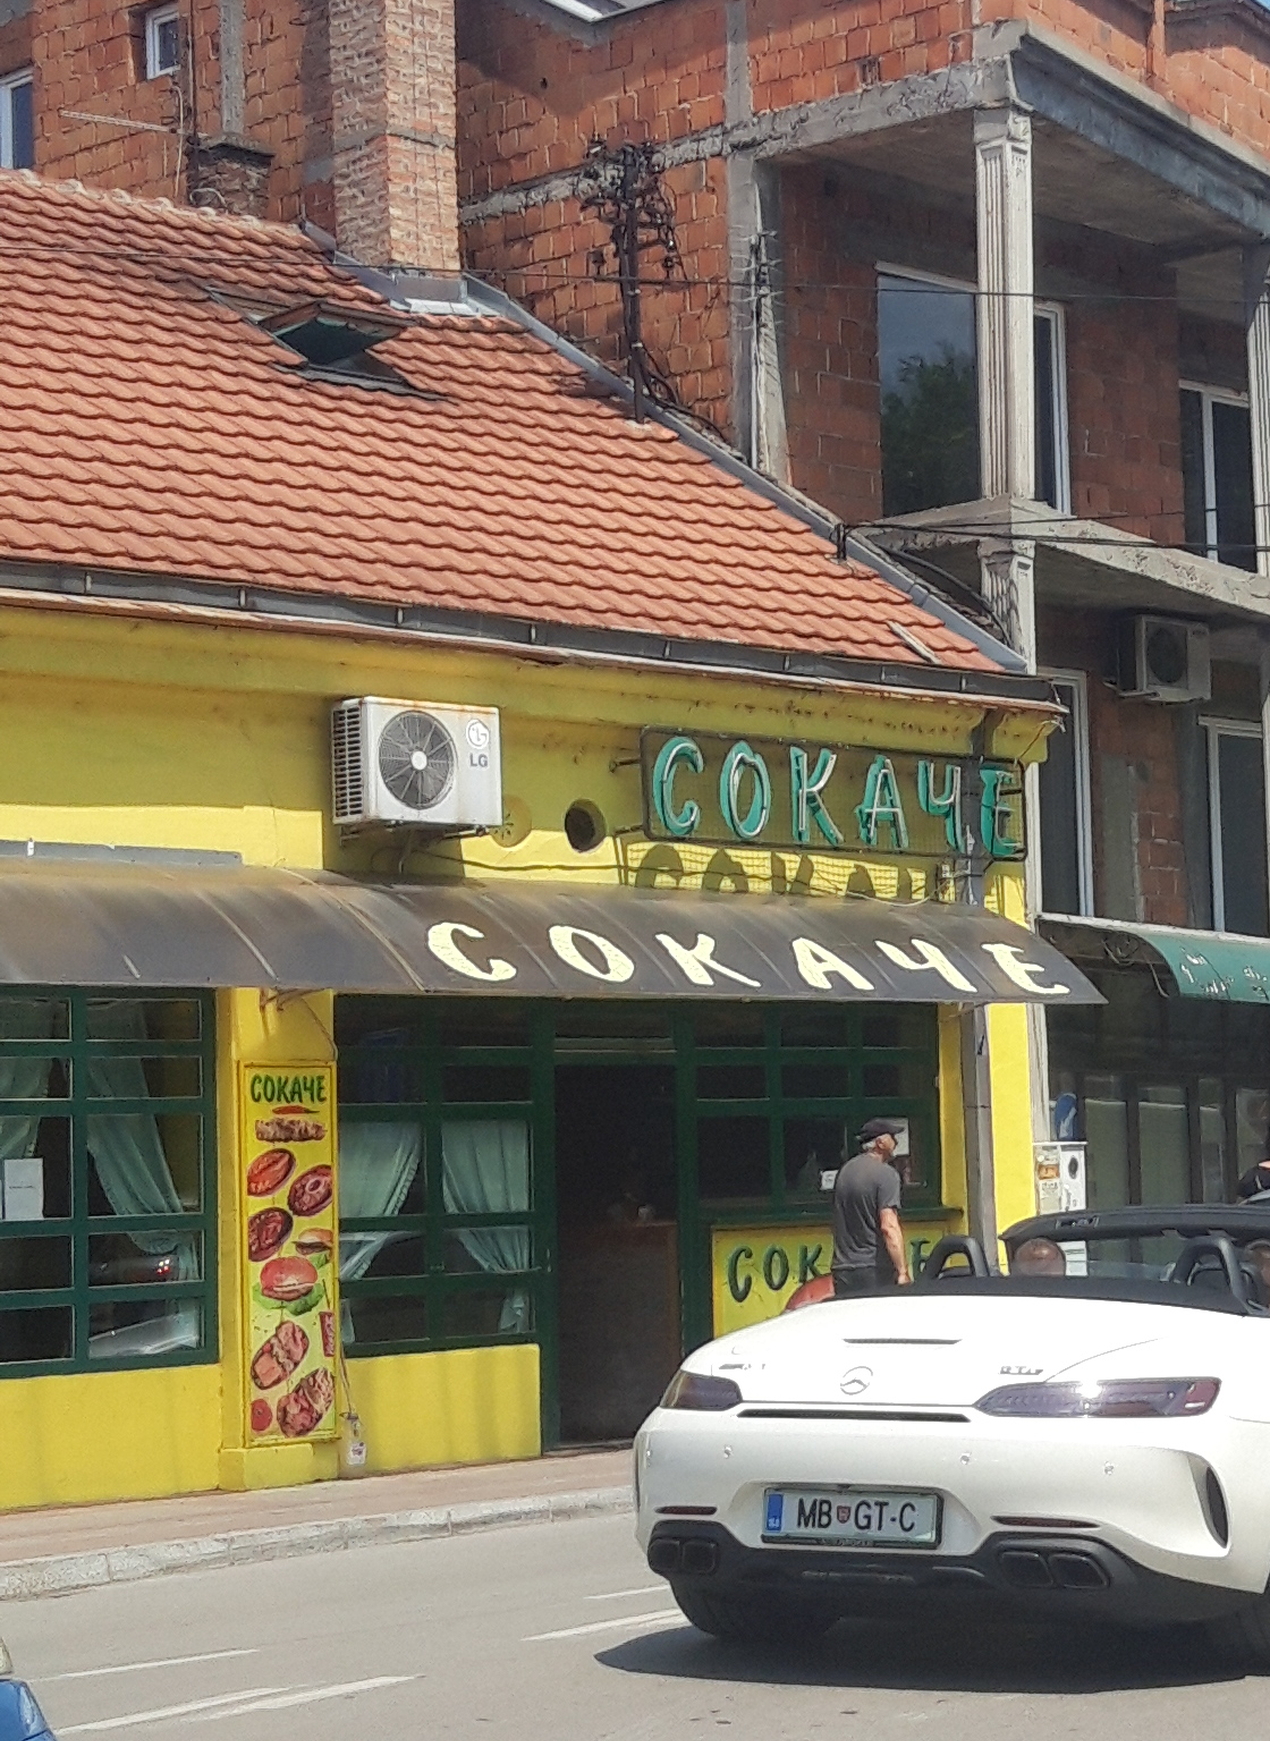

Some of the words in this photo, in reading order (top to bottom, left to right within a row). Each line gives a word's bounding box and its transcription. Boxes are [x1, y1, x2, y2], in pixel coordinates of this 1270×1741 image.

[470, 752, 488, 767] LG
[652, 736, 1025, 857] СОКАЧЕ
[427, 921, 1070, 995] СОКАЧЕ
[250, 1074, 327, 1104] СОКАЧЕ
[727, 1238, 932, 1303] СОКЕ
[797, 1498, 832, 1529] MB
[853, 1499, 916, 1533] GT-C
